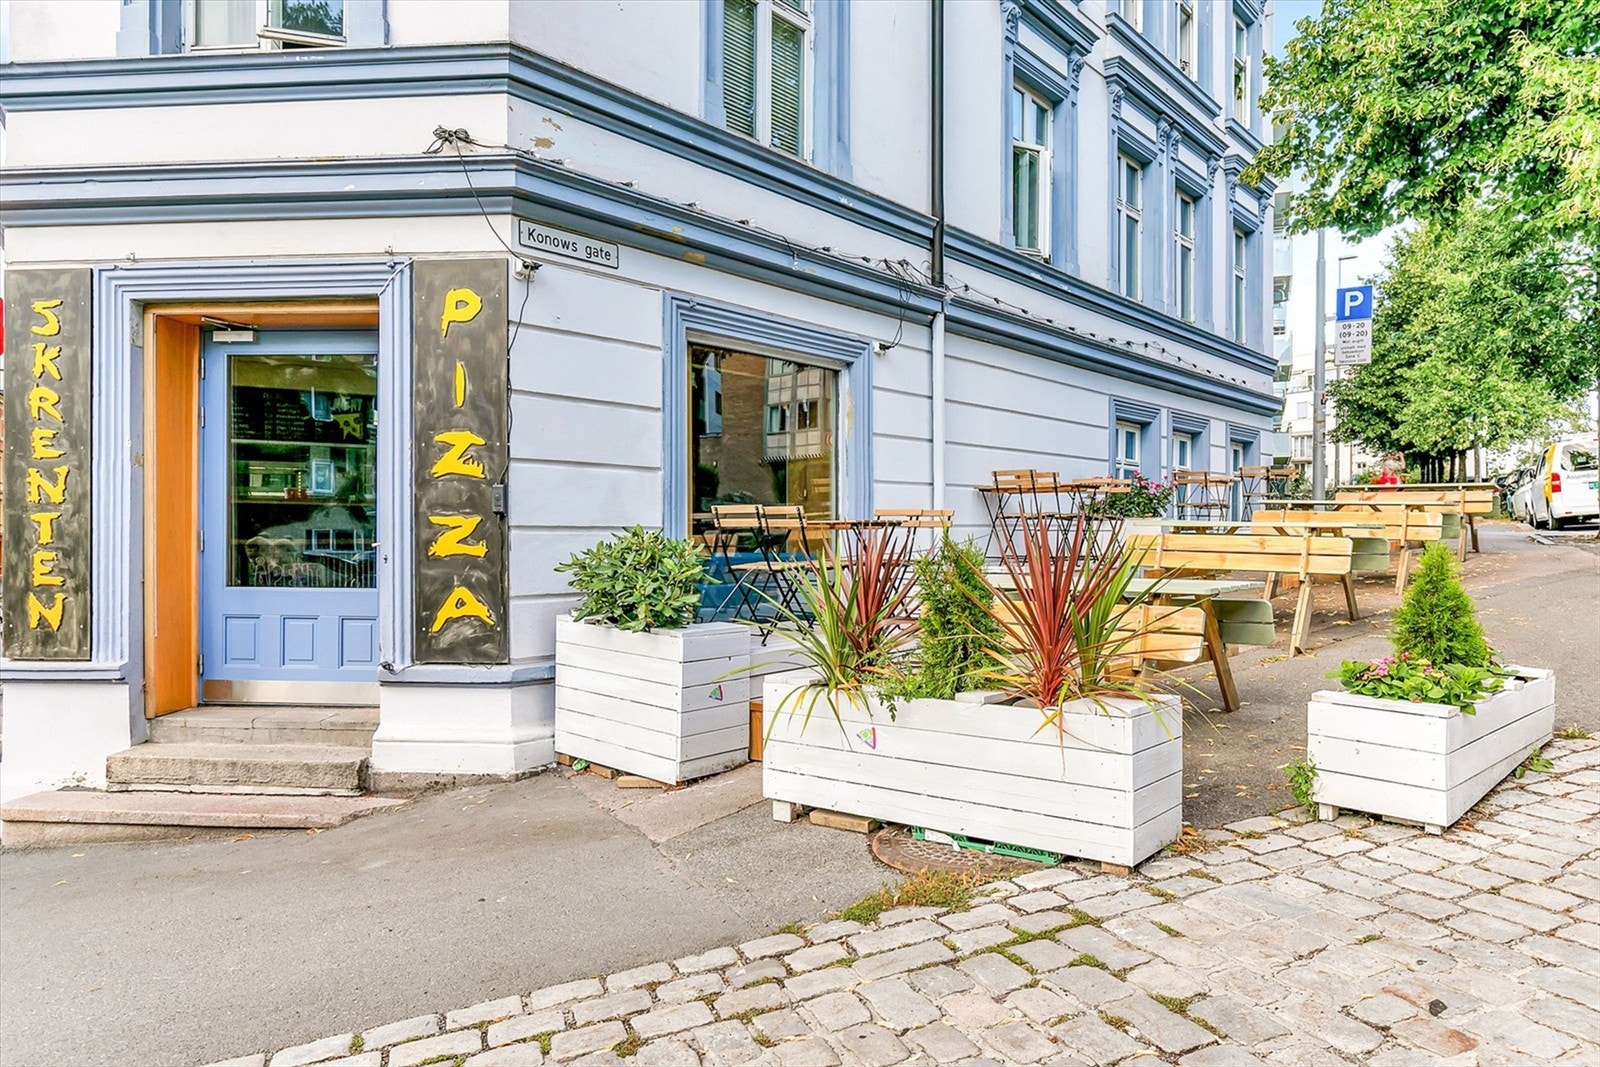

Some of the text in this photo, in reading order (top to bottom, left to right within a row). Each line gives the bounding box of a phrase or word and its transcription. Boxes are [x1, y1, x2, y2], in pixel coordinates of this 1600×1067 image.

[527, 227, 612, 261] Konows gate
[1344, 290, 1364, 317] P
[25, 298, 70, 633] SKRENTEN
[428, 288, 496, 633] PIZZA
